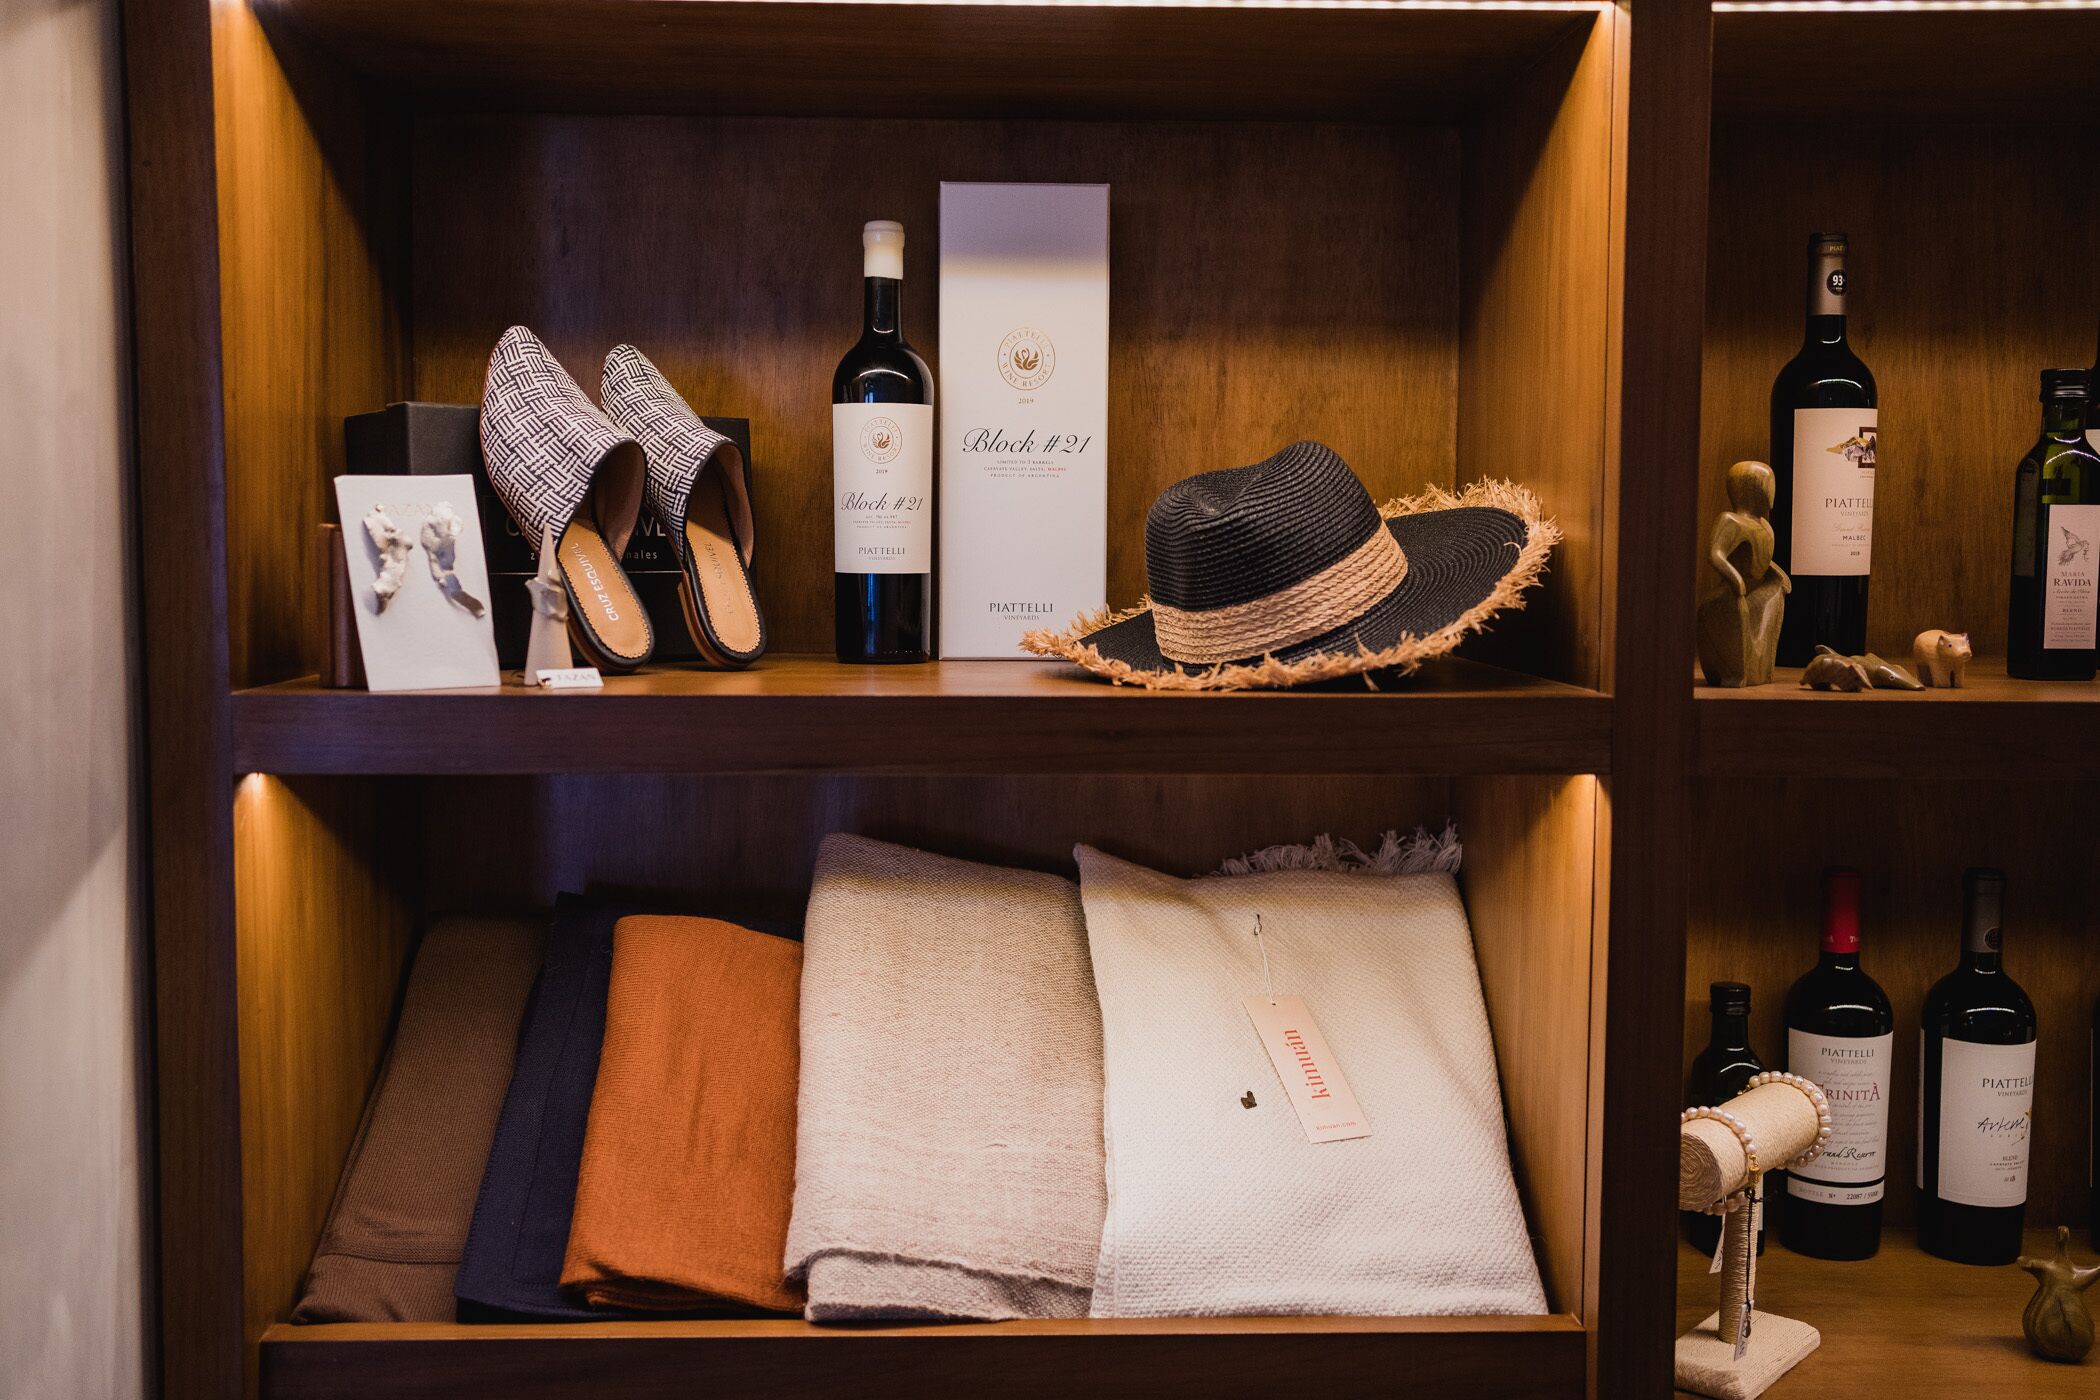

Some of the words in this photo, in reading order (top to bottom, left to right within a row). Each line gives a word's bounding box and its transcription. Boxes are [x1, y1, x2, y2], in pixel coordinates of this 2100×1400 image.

[1832, 275, 1843, 286] 93
[962, 427, 1039, 454] Block
[1043, 434, 1092, 454] #21
[841, 491, 892, 511] Block
[894, 496, 923, 511] #21
[1825, 498, 1873, 508] PIATTELL
[858, 547, 905, 555] PIATTELLI
[571, 543, 604, 592] ESQUIVEL
[2054, 578, 2092, 587] RAVIDA
[597, 592, 620, 621] CRUZ
[988, 603, 1053, 613] PIATTELLI
[1821, 1047, 1874, 1058] PIATTELLI
[1982, 1076, 2033, 1089] PIATTELL
